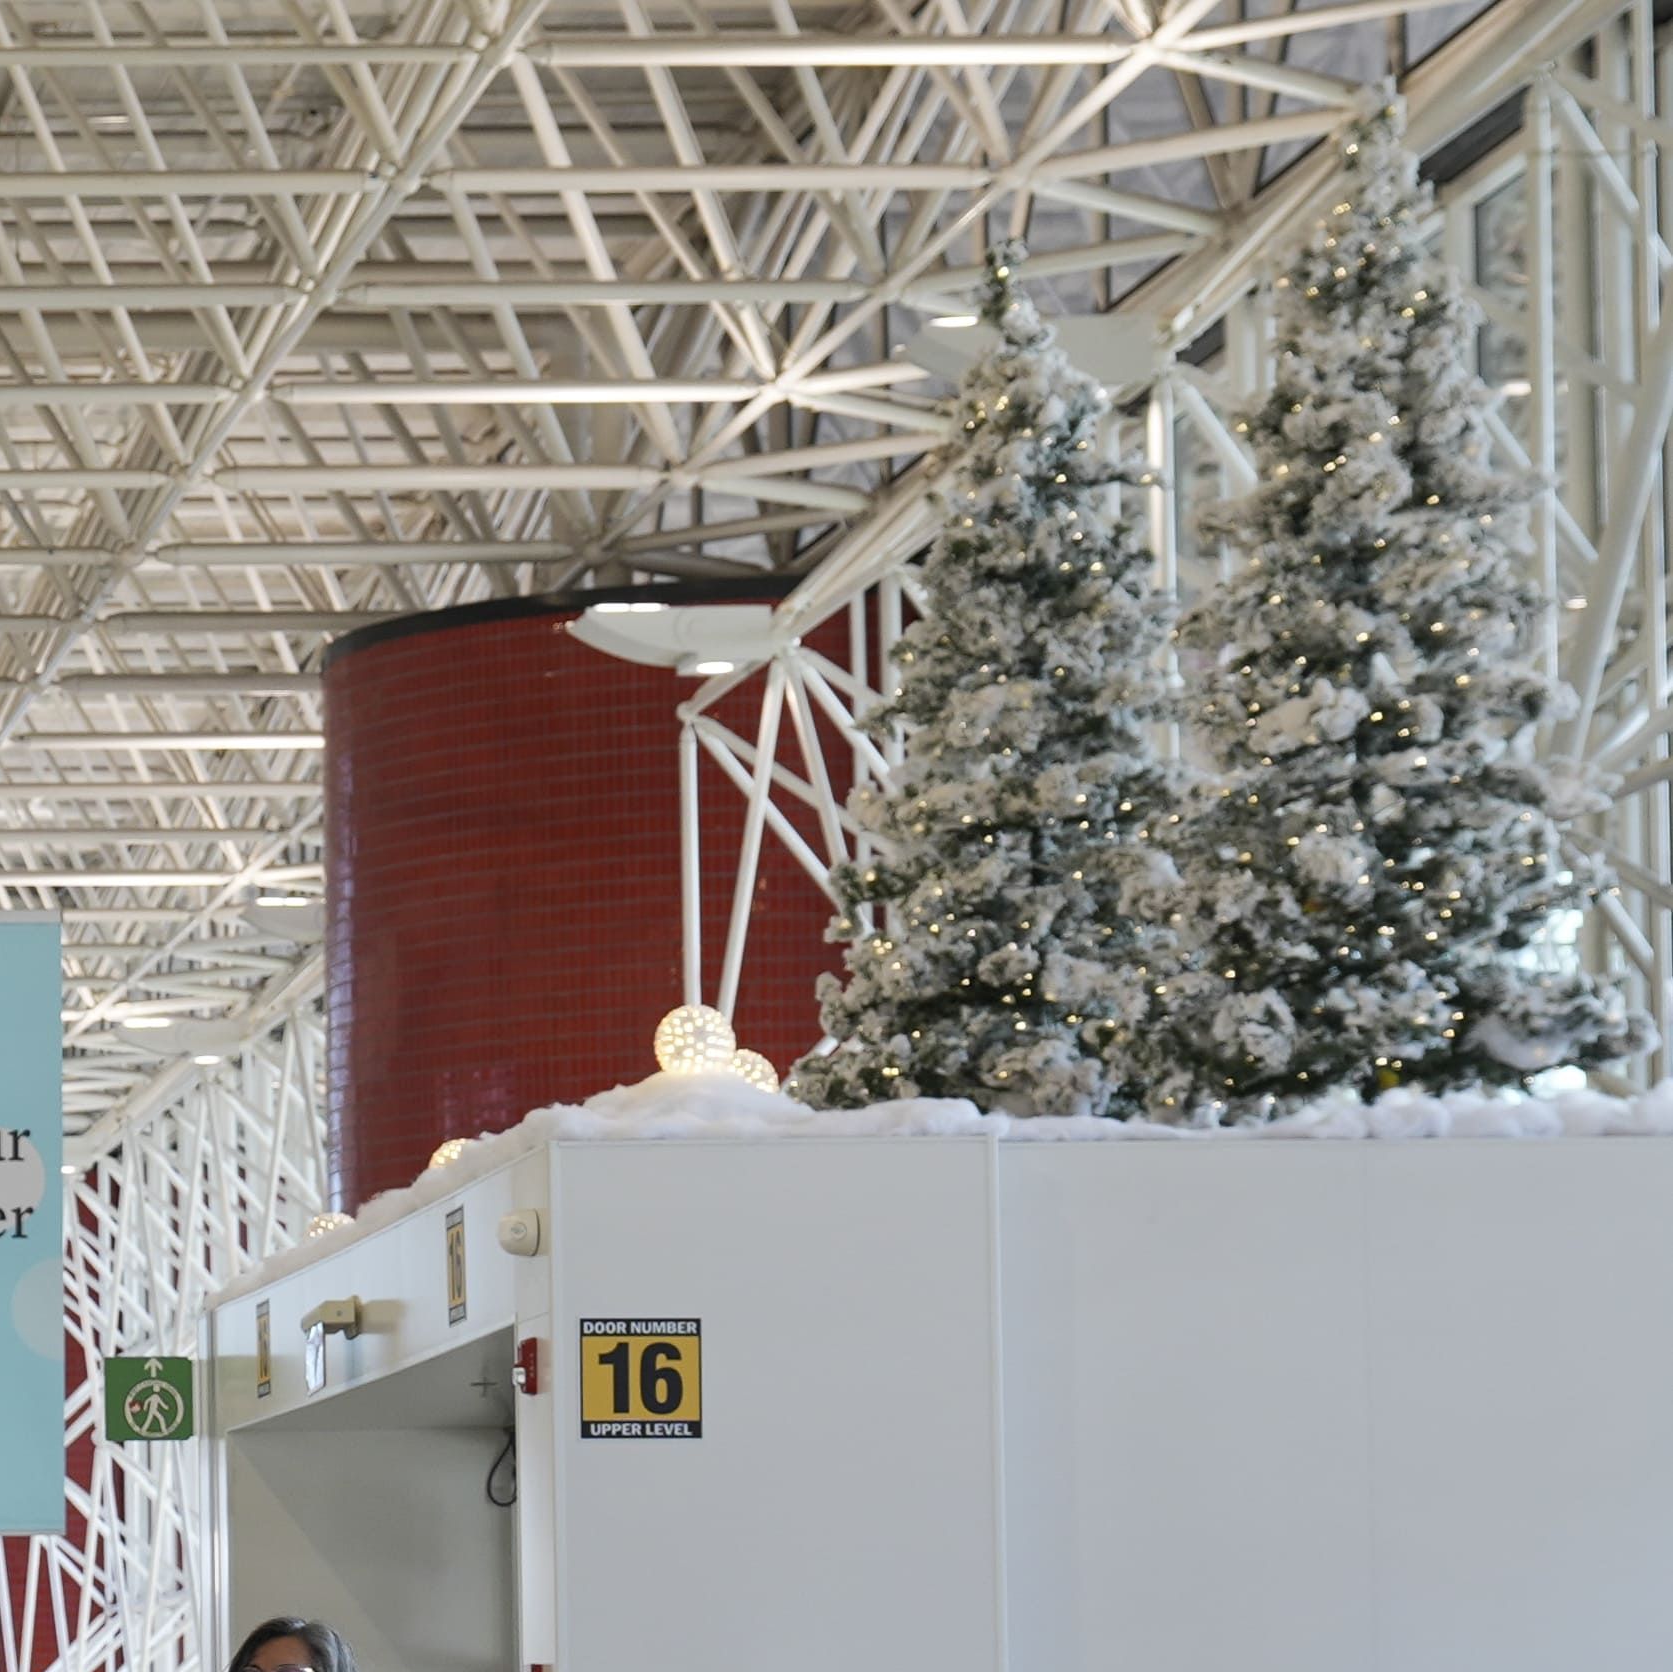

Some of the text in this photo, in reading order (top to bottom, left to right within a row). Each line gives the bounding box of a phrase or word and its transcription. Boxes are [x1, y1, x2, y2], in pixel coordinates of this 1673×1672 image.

[583, 1321, 698, 1334] DOOR NUMBER
[598, 1341, 684, 1415] 16
[590, 1422, 693, 1436] UPPER LEVEL
